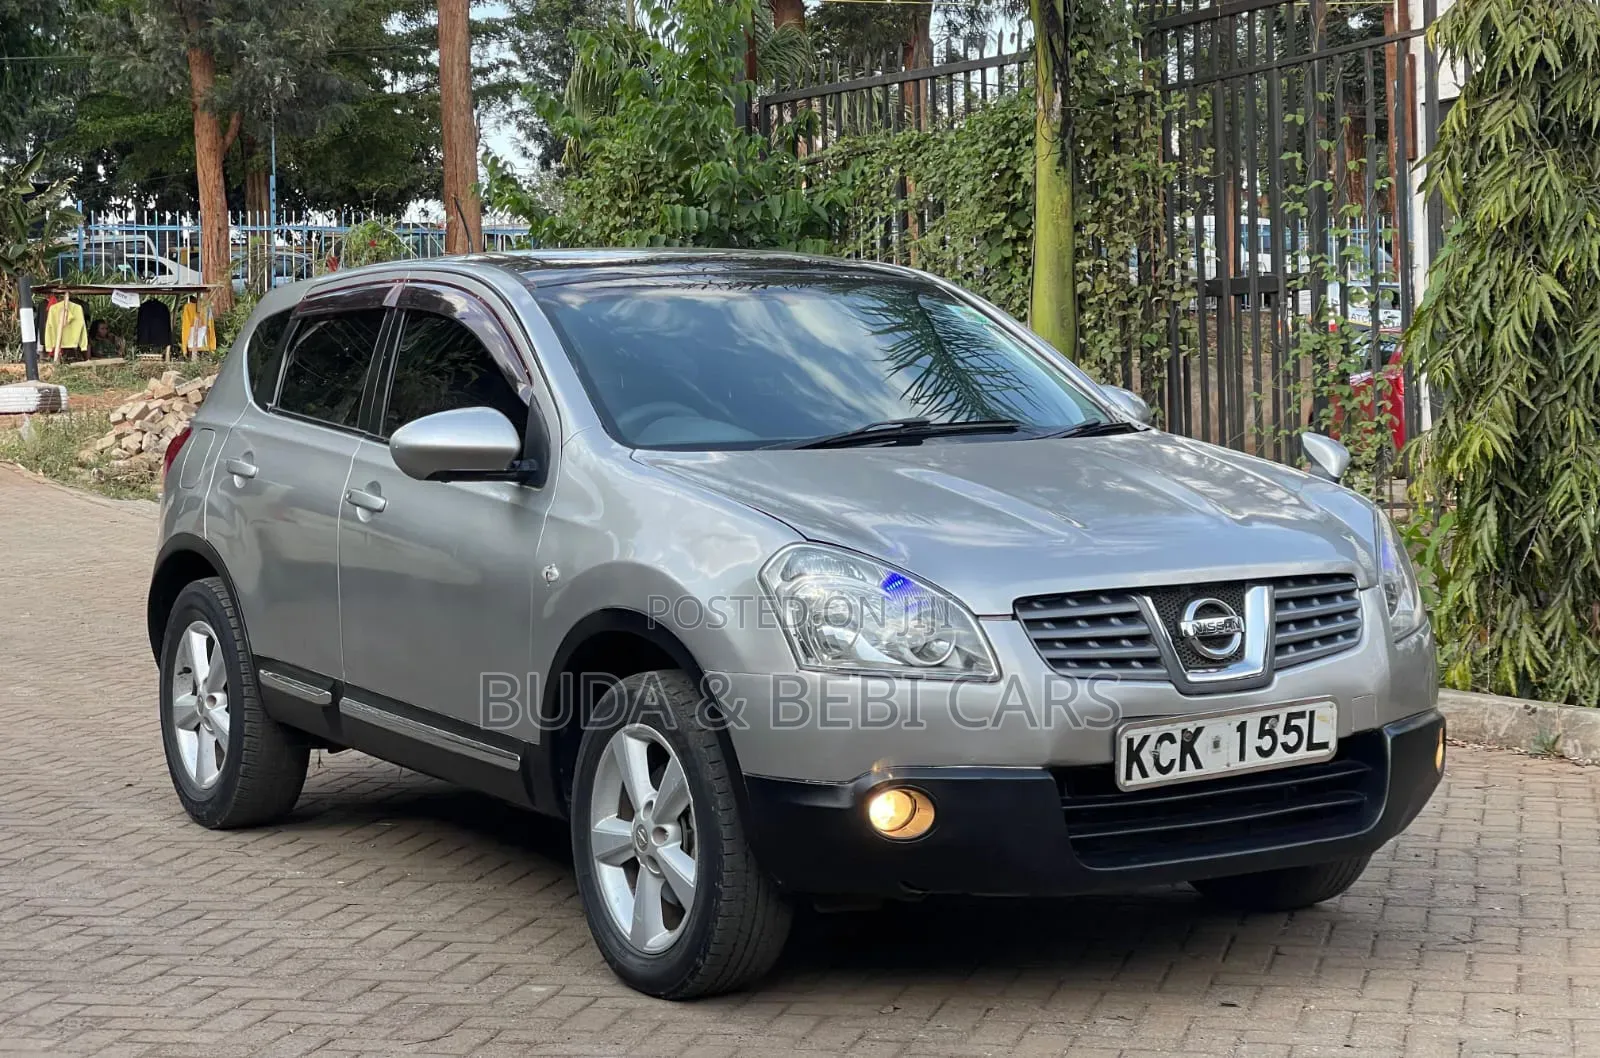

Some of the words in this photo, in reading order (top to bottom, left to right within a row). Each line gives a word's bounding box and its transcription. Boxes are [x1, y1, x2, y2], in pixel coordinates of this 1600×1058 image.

[1192, 618, 1241, 634] NISSAN
[1125, 726, 1206, 781] KCK
[1236, 710, 1330, 762] 155L
